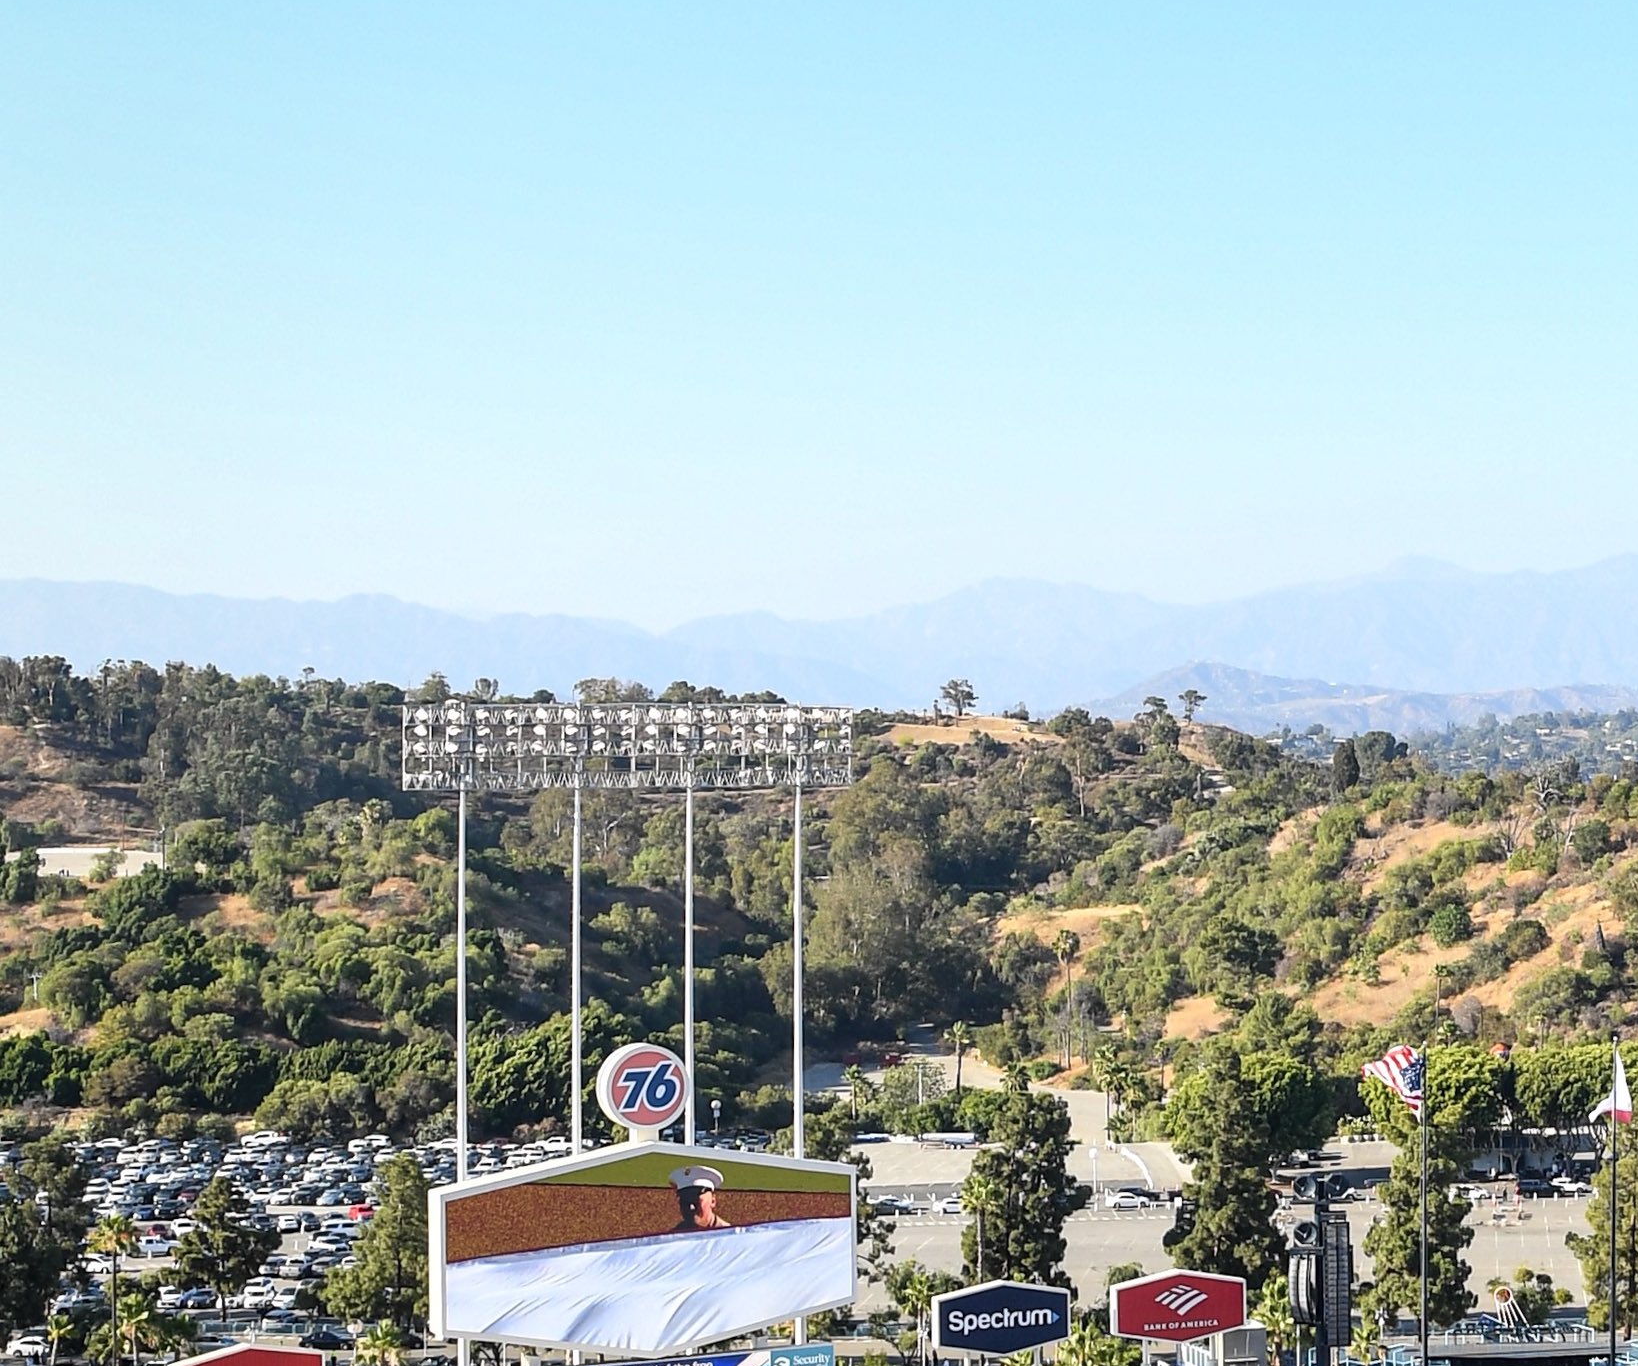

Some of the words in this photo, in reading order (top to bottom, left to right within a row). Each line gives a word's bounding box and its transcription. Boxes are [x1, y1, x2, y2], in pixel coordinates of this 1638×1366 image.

[618, 1061, 679, 1111] 76
[948, 1308, 1052, 1335] Spectrum
[1143, 1324, 1167, 1332] BANK
[1168, 1322, 1178, 1330] OF
[1178, 1319, 1220, 1329] AMERICA
